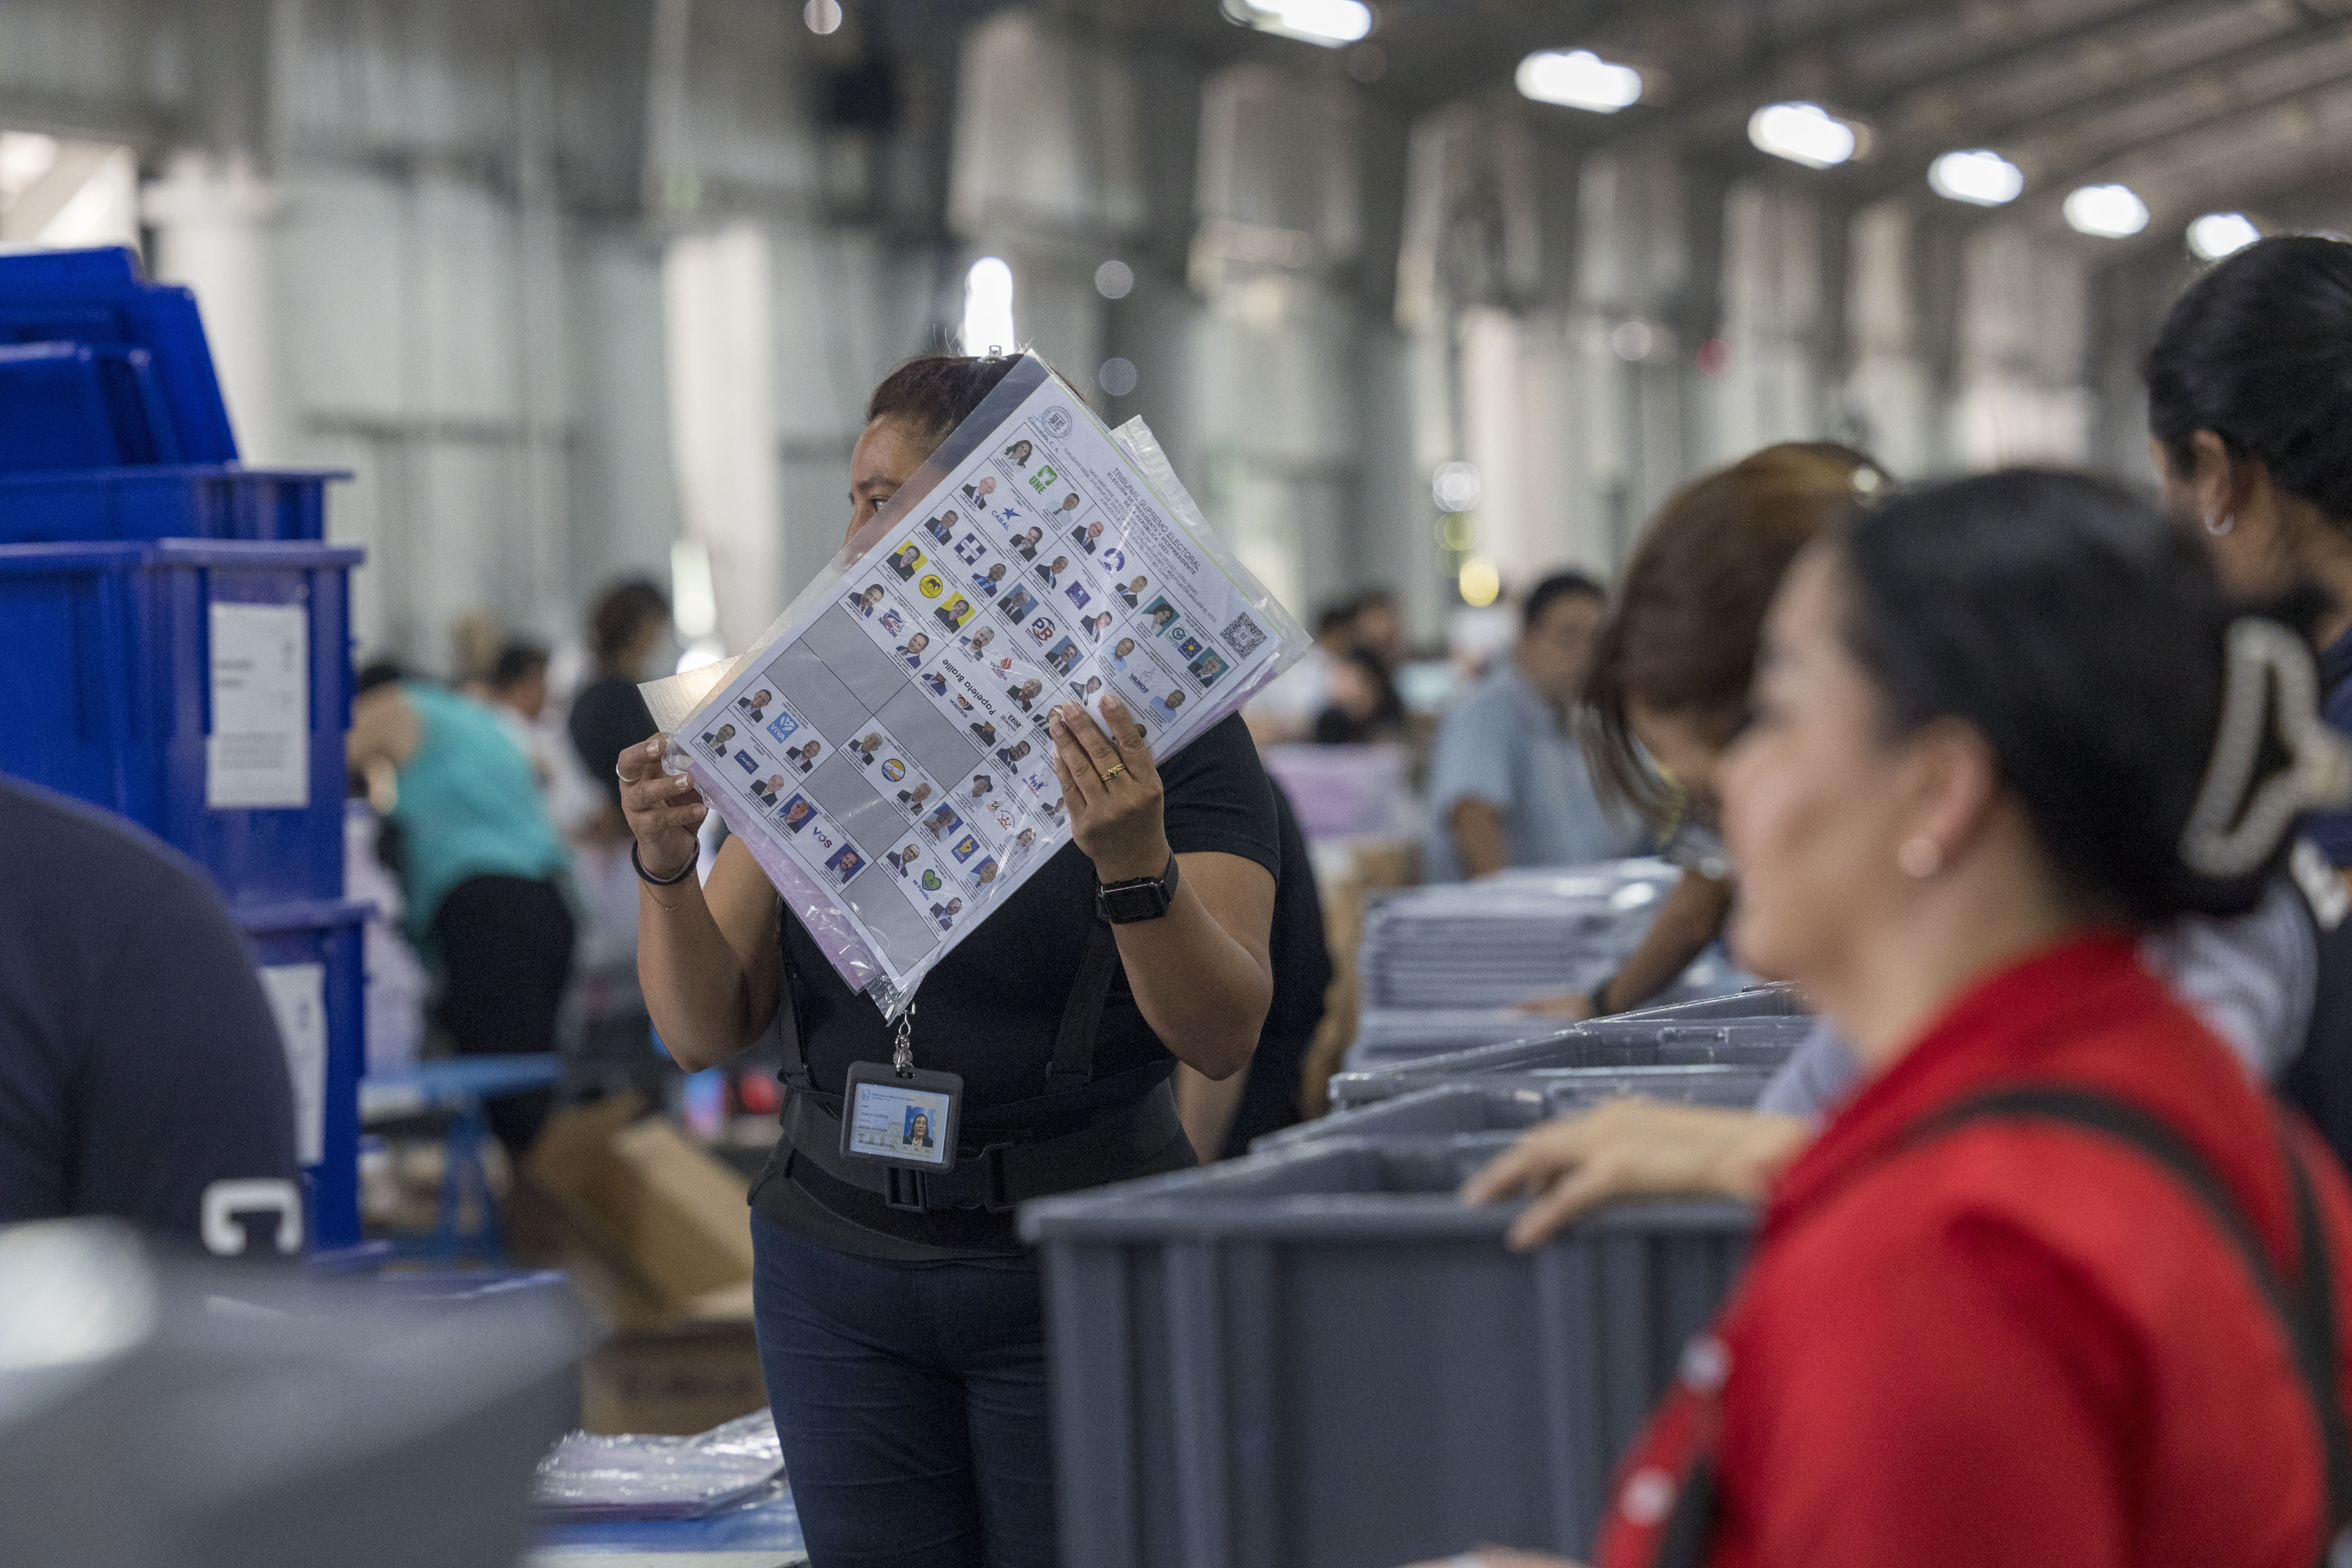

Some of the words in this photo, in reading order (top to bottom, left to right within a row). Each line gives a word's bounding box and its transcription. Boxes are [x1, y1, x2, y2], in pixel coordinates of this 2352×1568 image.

[1027, 475, 1047, 495] UNE
[991, 509, 1011, 531] CABAL
[1111, 466, 1142, 501] TRIBUNAL
[1138, 498, 1169, 534] SUPREMO
[1166, 531, 1202, 571] ELECTORAL
[1126, 495, 1134, 503] DE
[1132, 503, 1159, 533] PRESIDENTE
[1160, 535, 1196, 576] VICEPRESIDENTE
[1067, 592, 1081, 608] TODOS
[891, 619, 901, 630] FCN
[1031, 617, 1054, 642] PR
[940, 657, 965, 683] Braille
[989, 660, 1008, 681] VICTORIA
[1129, 672, 1149, 694] VAMOS
[962, 679, 998, 715] Papeleta
[949, 699, 968, 719] NOSOTROS
[1007, 714, 1021, 729] 2023
[769, 724, 786, 741] VIVA
[753, 744, 764, 756] CAMBIO
[738, 753, 755, 771] CAMBIO
[996, 817, 1008, 830] WINAQ
[811, 826, 833, 849] VOS
[953, 848, 965, 861] BIEN
[916, 884, 930, 901] Familia
